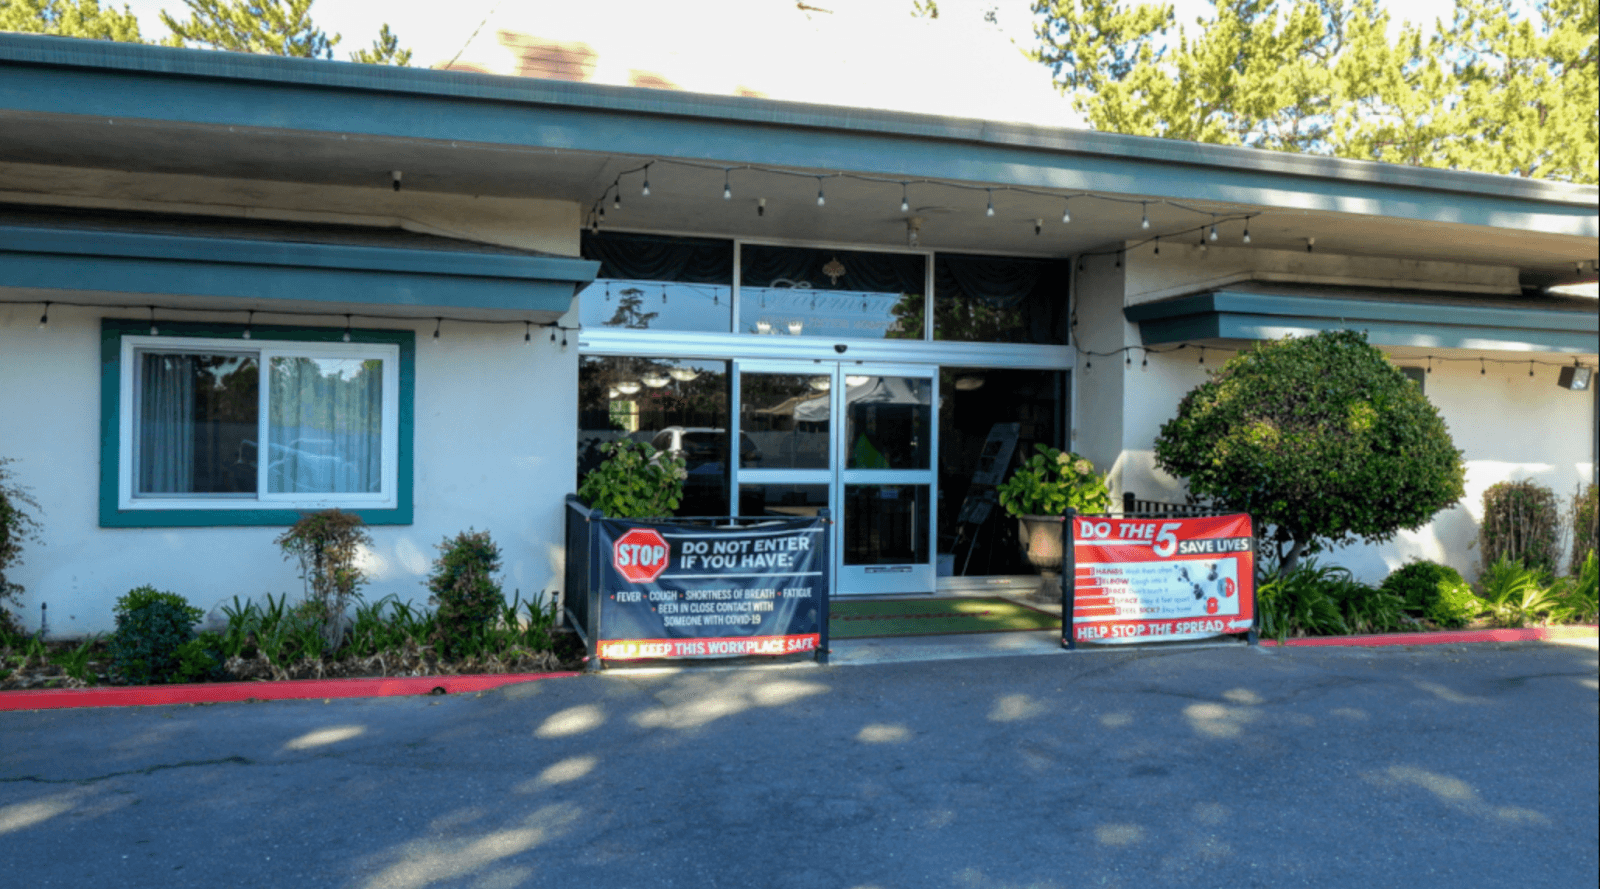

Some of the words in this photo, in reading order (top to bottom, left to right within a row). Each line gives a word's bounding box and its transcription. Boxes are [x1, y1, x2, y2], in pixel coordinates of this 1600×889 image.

[681, 541, 709, 554] DO
[714, 540, 752, 554] NOT
[753, 537, 810, 551] ENTER
[1080, 521, 1112, 538] DO
[1118, 524, 1156, 539] THE
[1153, 523, 1182, 557] 5
[1179, 540, 1213, 554] SAVE
[1216, 538, 1249, 552] LIVES
[618, 544, 665, 566] STOP
[681, 555, 698, 569] IF
[701, 555, 737, 568] YOU
[741, 553, 794, 568] HAVE:
[617, 592, 641, 602] FEVER
[650, 591, 677, 601] COUGH
[685, 589, 732, 600] SHORTNESS
[733, 589, 743, 599] OF
[744, 588, 775, 599] BREATH
[783, 587, 812, 598] FATIGUE
[658, 603, 679, 614] BEEN
[680, 603, 689, 613] IN
[690, 603, 715, 613] CLOSE
[716, 602, 752, 612] CONTACT
[752, 601, 774, 611] WITH
[664, 615, 703, 626] SOMEONE
[703, 614, 724, 625] WITH
[725, 614, 762, 625] COVID-19
[1077, 626, 1108, 639] HELP
[1112, 624, 1145, 637] STOP
[1149, 623, 1172, 635] THE
[1176, 619, 1224, 634] SPREAD
[602, 643, 637, 658] HELP
[639, 643, 672, 657] KEEP
[675, 642, 705, 655] THIS
[707, 639, 785, 655] WORKPLACE
[787, 637, 814, 650] SAFE
